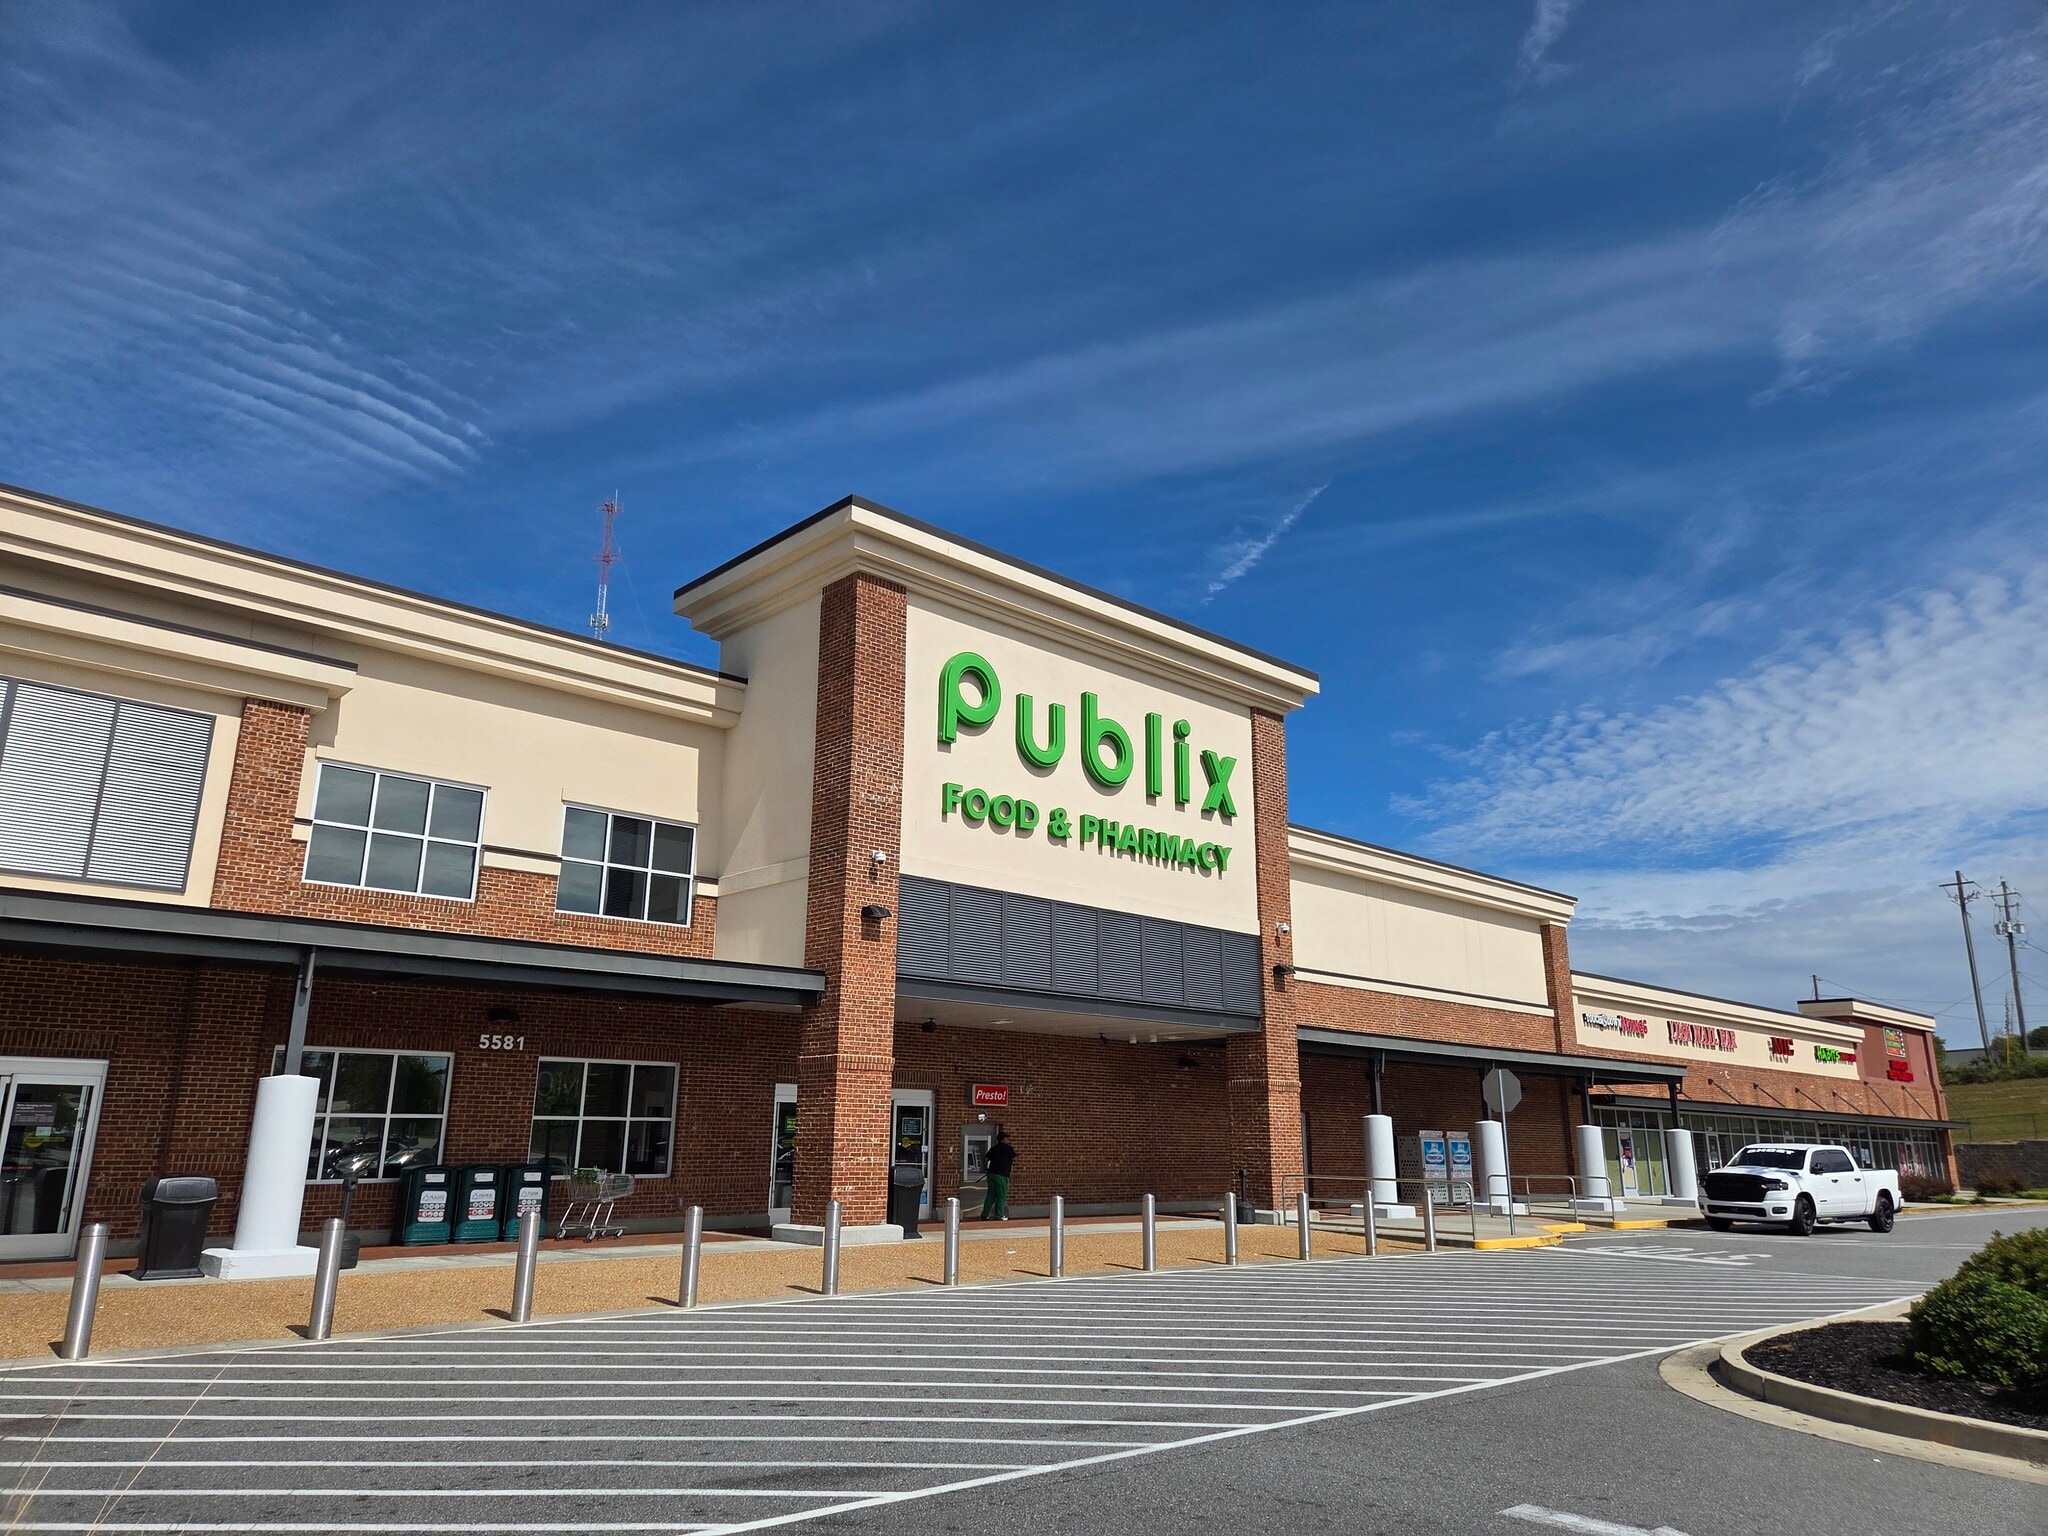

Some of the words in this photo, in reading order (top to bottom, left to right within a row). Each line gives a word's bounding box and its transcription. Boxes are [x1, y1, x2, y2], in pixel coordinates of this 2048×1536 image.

[939, 651, 1238, 818] Publix
[942, 782, 1040, 830] FOOD
[1048, 807, 1073, 839] &
[1080, 814, 1233, 872] PHARMACY
[478, 1034, 525, 1051] 5581
[976, 1090, 1006, 1101] Presto!
